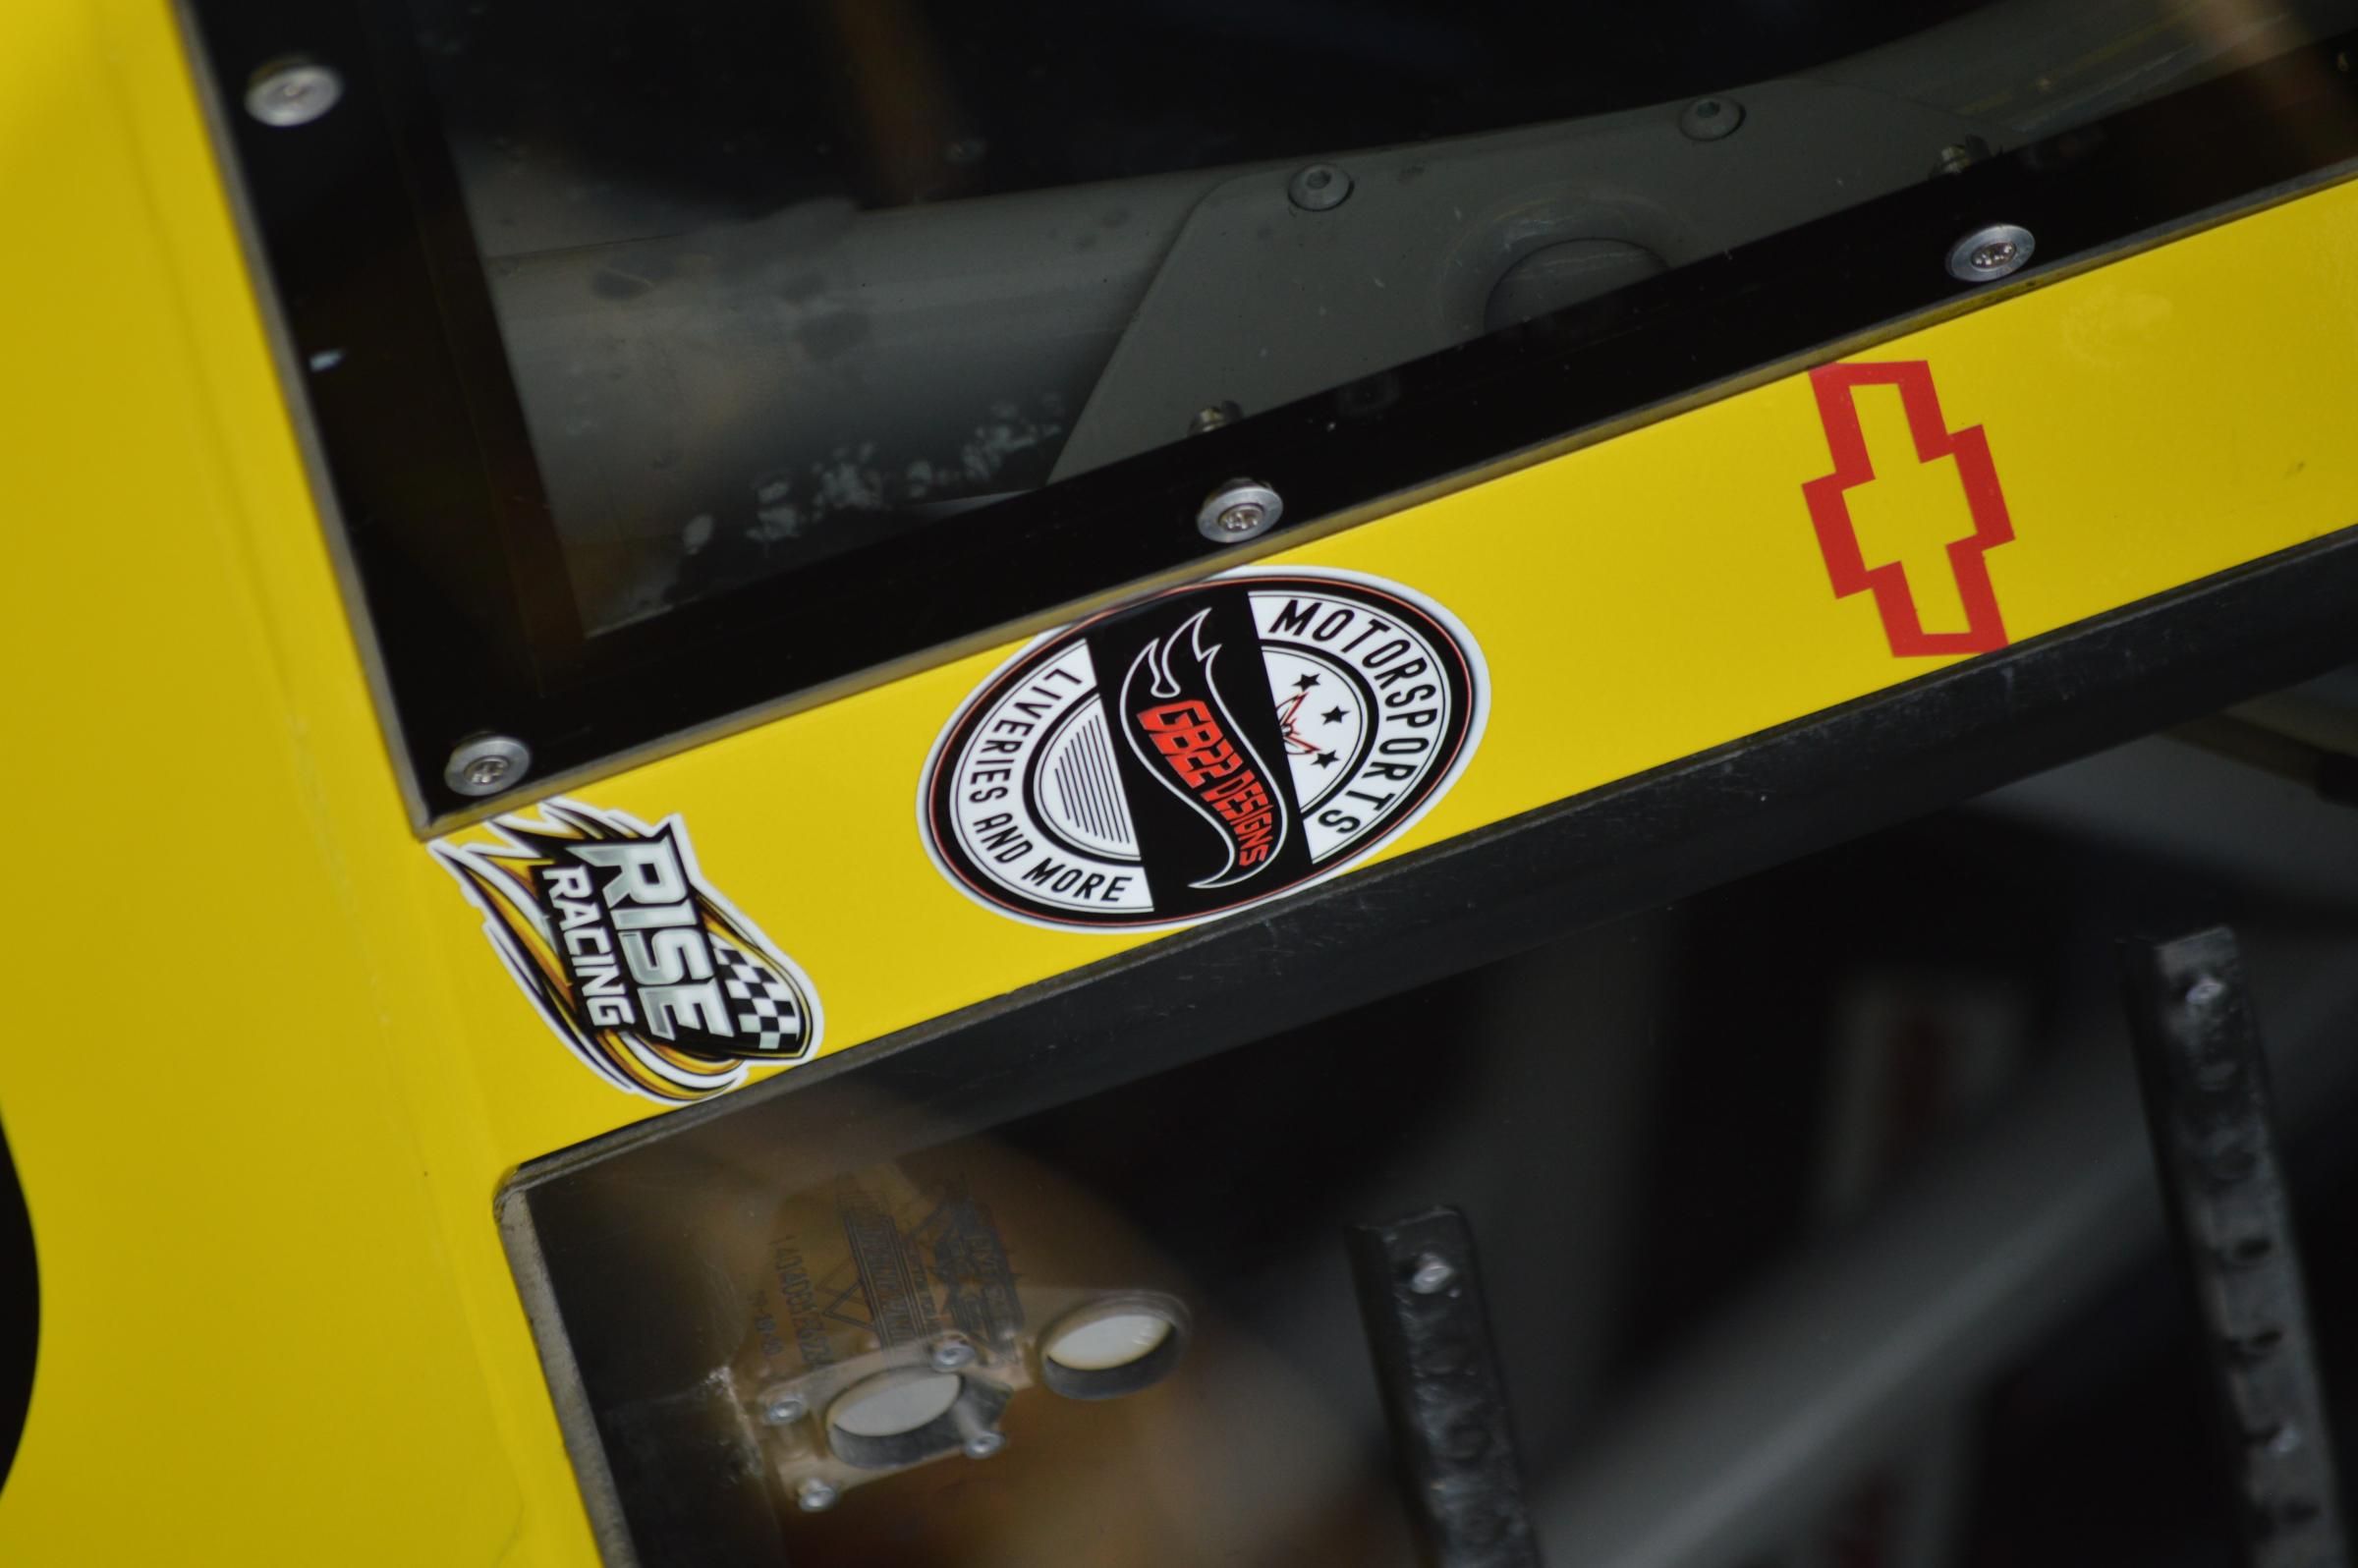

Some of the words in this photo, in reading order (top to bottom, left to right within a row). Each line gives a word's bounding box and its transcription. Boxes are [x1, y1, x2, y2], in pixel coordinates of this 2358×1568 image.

[969, 666, 1082, 806] LIVERIES
[1136, 699, 1228, 790] GB22
[1200, 773, 1275, 868] DESIGNS
[1268, 597, 1438, 836] MOTORSPORTS
[973, 813, 1035, 865] AND
[1025, 862, 1134, 903] MORE
[542, 865, 637, 1028] RACING
[564, 838, 735, 1041] RISE
